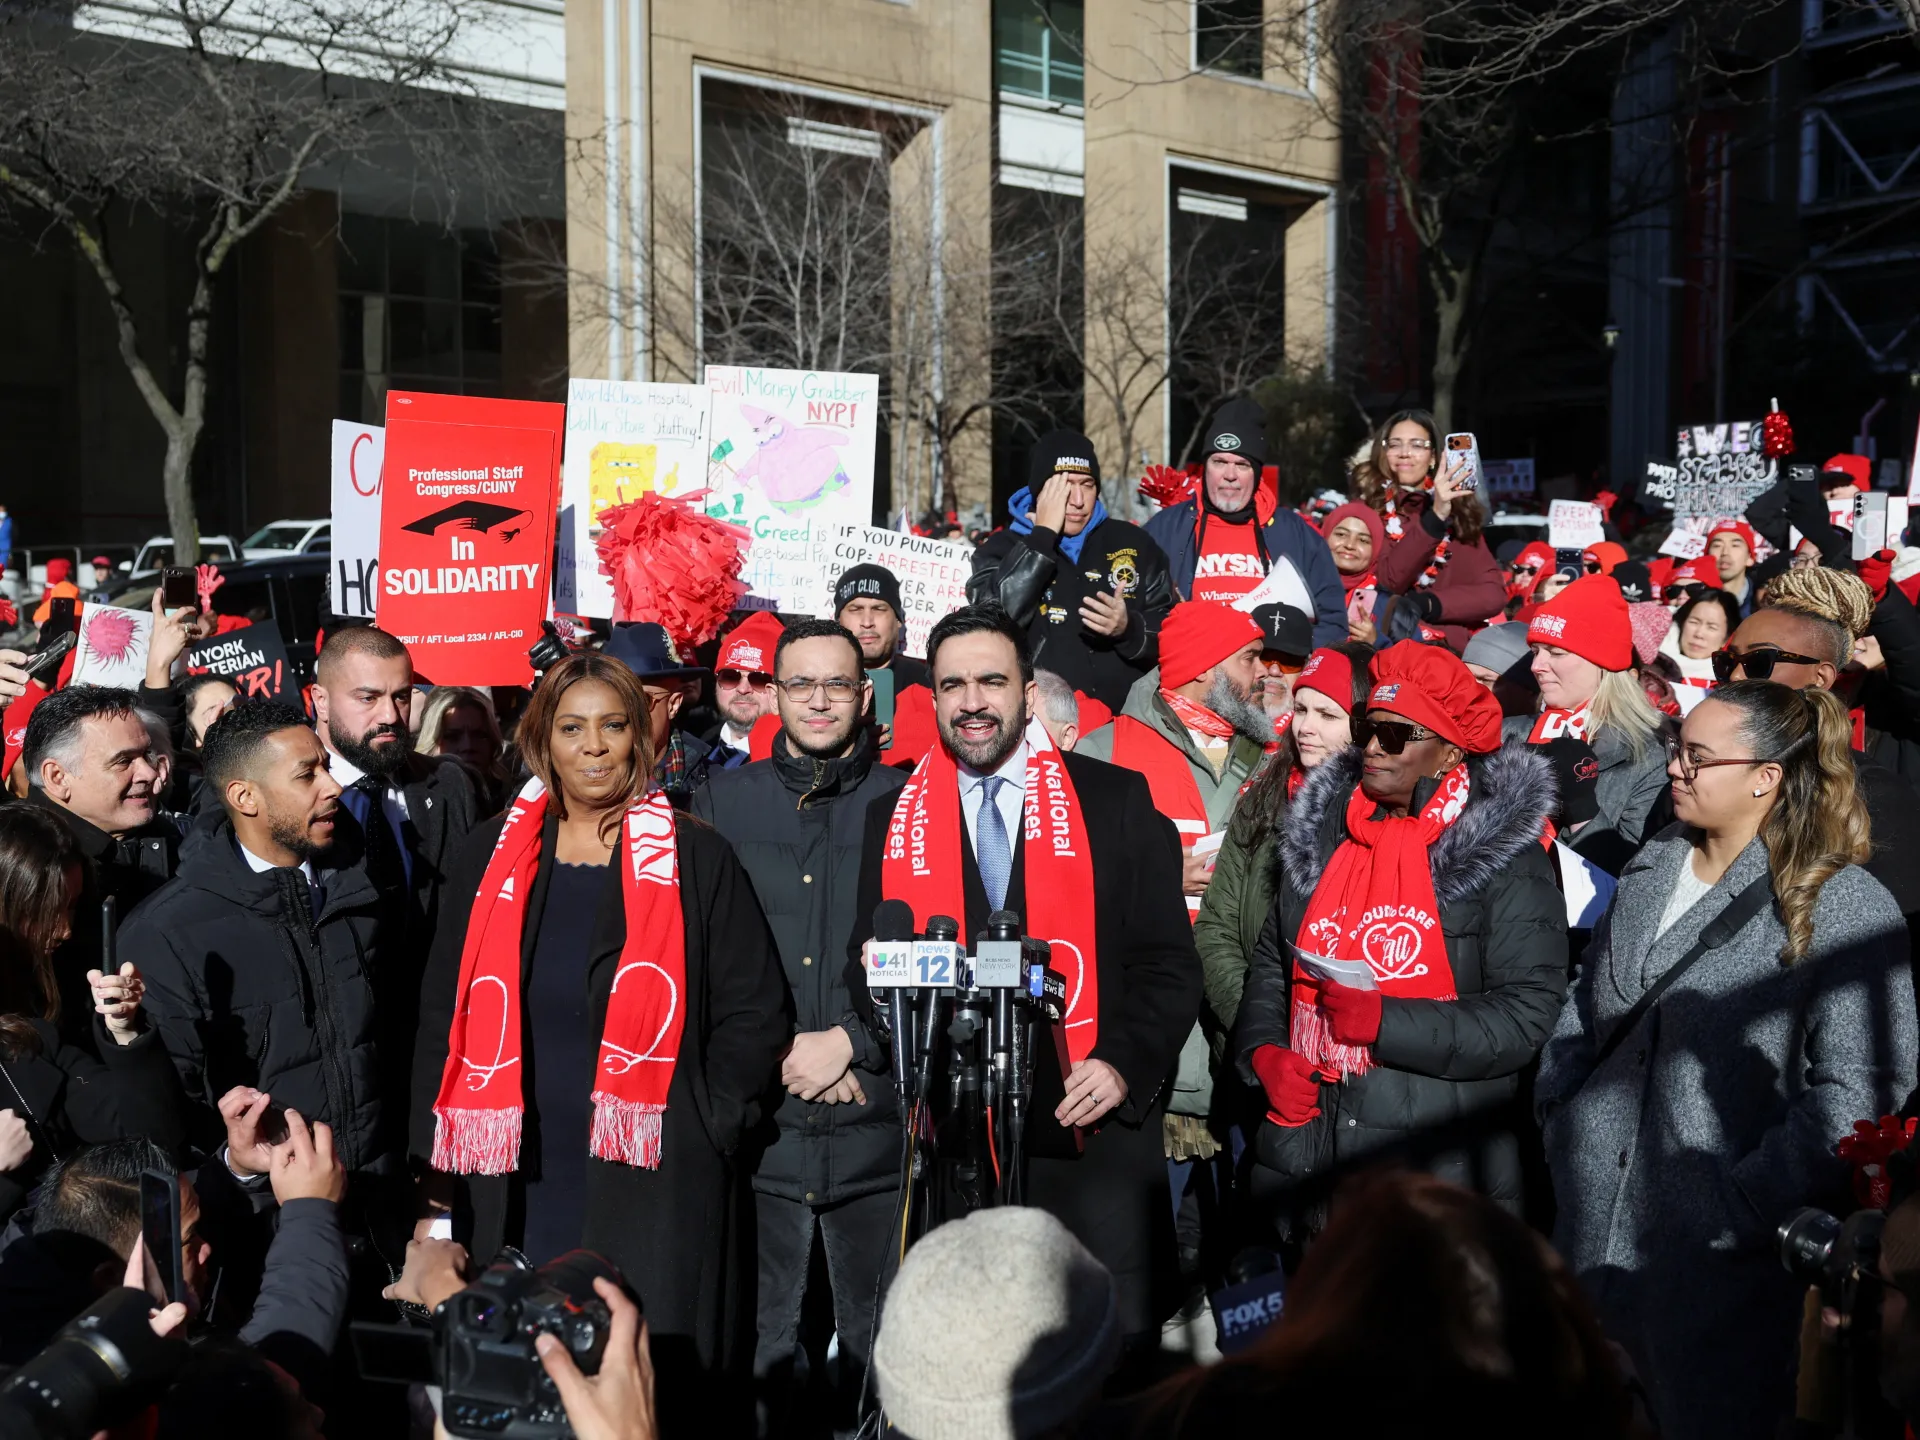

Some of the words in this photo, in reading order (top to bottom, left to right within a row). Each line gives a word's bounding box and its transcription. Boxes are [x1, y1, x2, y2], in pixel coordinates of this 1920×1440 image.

[745, 370, 798, 408] Money
[802, 373, 874, 402] Grabber
[568, 404, 608, 433] Dollar
[615, 406, 645, 434] Store
[807, 401, 857, 428] NYP!
[1692, 421, 1752, 456] WE
[408, 466, 489, 483] Professional
[491, 465, 524, 480] Staff
[1056, 456, 1090, 468] AMAZON
[415, 480, 517, 498] Congress/CUNY
[754, 515, 811, 542] Greed
[816, 525, 828, 542] is
[450, 536, 475, 561] In
[840, 526, 857, 538] IF
[862, 530, 895, 547] YOU
[900, 537, 953, 559] PUNCH
[961, 550, 972, 562] A
[834, 543, 873, 563] COP:
[875, 552, 964, 583] ARRESTED
[384, 563, 540, 596] SOLIDARITY
[857, 578, 880, 595] CLUB
[426, 635, 443, 644] AFT
[444, 634, 465, 644] Local
[467, 633, 487, 643] 2334
[494, 629, 524, 640] AFL-CIO
[200, 638, 246, 663] YORK
[1024, 767, 1042, 841] Nurses
[1043, 760, 1077, 858] National
[890, 784, 918, 860] Nurses
[1398, 904, 1436, 930] CARE
[888, 952, 907, 969] 41
[917, 943, 950, 954] news
[1381, 933, 1411, 968] All
[916, 955, 950, 983] 12
[1221, 1297, 1268, 1330] FOX
[1267, 1291, 1284, 1314] 5
